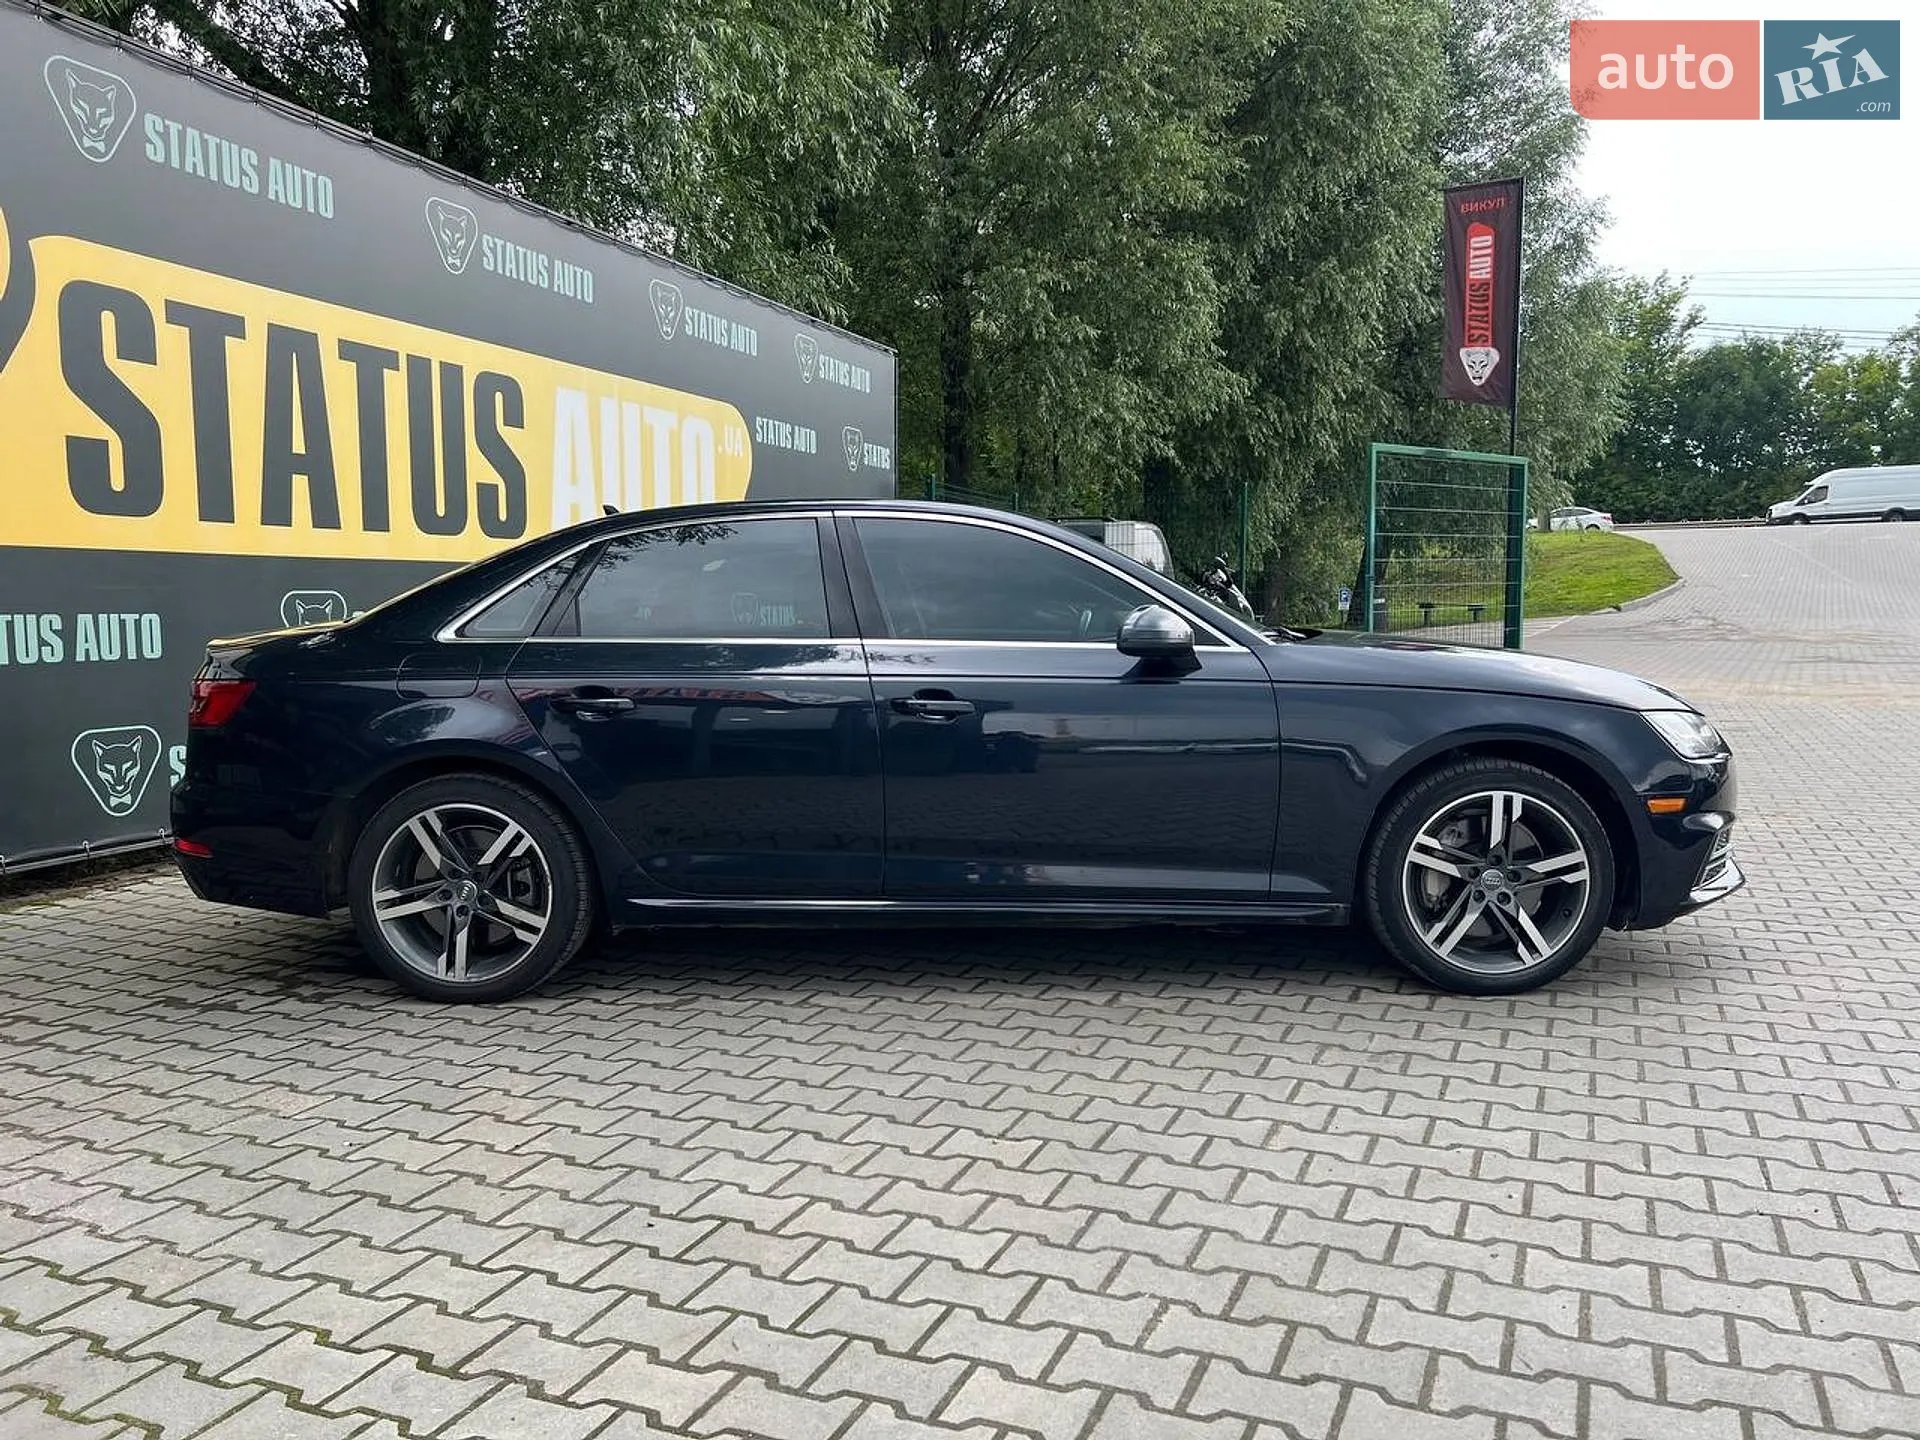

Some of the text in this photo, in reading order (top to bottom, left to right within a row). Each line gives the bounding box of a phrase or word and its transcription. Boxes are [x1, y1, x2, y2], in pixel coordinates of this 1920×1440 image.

[144, 112, 334, 219] STATUS AUTO
[481, 234, 594, 304] STATUS AUTO
[1468, 235, 1493, 344] STATUS AUTO
[684, 306, 758, 357] STATUS AUTO
[818, 354, 871, 394] STATUS AUTO
[58, 279, 528, 539] STATUS
[551, 386, 716, 532] AUTO
[755, 416, 817, 454] STATUS AUTO
[863, 442, 891, 470] STATUS
[75, 613, 163, 662] AUTO
